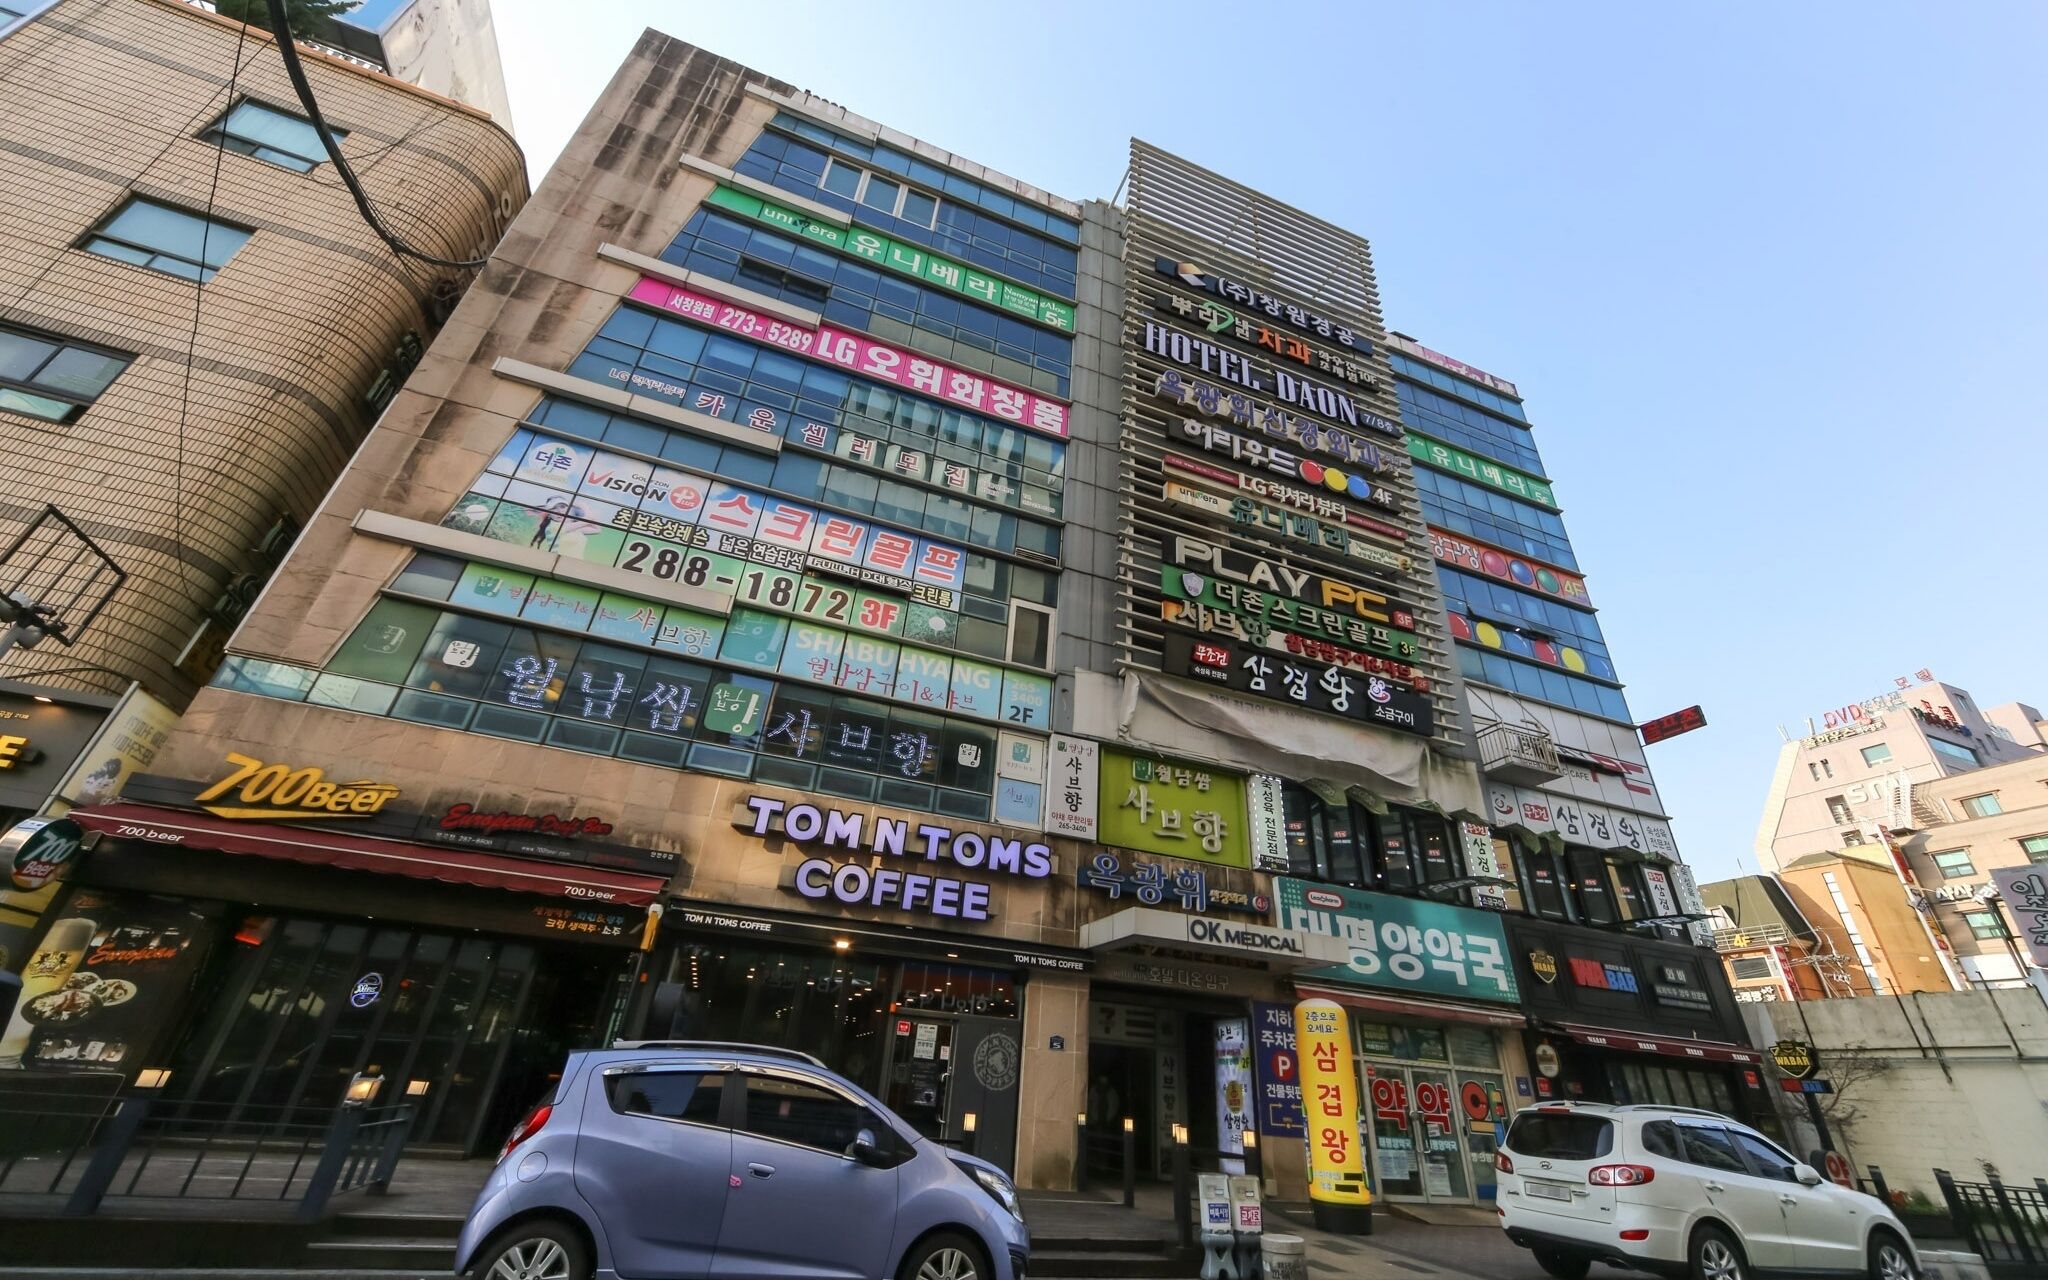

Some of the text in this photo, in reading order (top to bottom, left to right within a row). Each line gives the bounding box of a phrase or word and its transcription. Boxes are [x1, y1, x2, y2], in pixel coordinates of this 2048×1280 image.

[850, 235, 997, 300] 유니베라
[1045, 311, 1067, 328] 5F
[1258, 326, 1311, 366] 치과
[817, 330, 858, 366] LG
[863, 346, 1063, 434] 오휘화장품
[1144, 321, 1261, 391] HOTEL
[1275, 370, 1358, 427] DAON
[1431, 446, 1527, 494] 유니베라
[1372, 487, 1393, 505] 4F
[708, 493, 961, 583] 스크린골프
[1229, 496, 1350, 556] 유니베라
[621, 541, 898, 630] 288-1872 3F
[1175, 536, 1310, 598] PLAY
[1321, 579, 1390, 622] PC
[1563, 579, 1584, 597] 4F
[1178, 600, 1271, 648] 샤브향
[1401, 641, 1415, 655] 3F
[1243, 654, 1354, 712] 삼겹왕
[1008, 705, 1034, 723] 2F
[1375, 706, 1414, 725] 소금구이
[1824, 703, 1862, 728] DVD
[1065, 756, 1083, 813] 샤브향
[1156, 764, 1211, 791] 월남쌈
[1571, 769, 1590, 782] CAFE
[1058, 821, 1087, 833] 265-3400
[1120, 784, 1228, 853] 샤브향
[116, 825, 185, 843] 700 beer
[747, 795, 1053, 880] TOM N TOMS
[22, 860, 56, 876] Beer
[564, 886, 616, 900] 700 beer
[794, 857, 992, 921] COFFEE
[685, 913, 772, 932] TOM N TOMS COFFEE
[1190, 918, 1302, 953] OK MEDICAL
[1014, 955, 1031, 964] TOM
[1038, 957, 1057, 968] TOMS
[1058, 960, 1084, 970] COFFEE
[1205, 972, 1230, 990] 입구
[1266, 1010, 1292, 1027] 지하
[1305, 1011, 1337, 1022] 2층으로
[1278, 1056, 1291, 1077] P
[1775, 1056, 1810, 1066] WABAR
[1312, 1040, 1349, 1165] 삼겹왕
[1371, 1078, 1409, 1131] 약
[1415, 1082, 1452, 1135] 약
